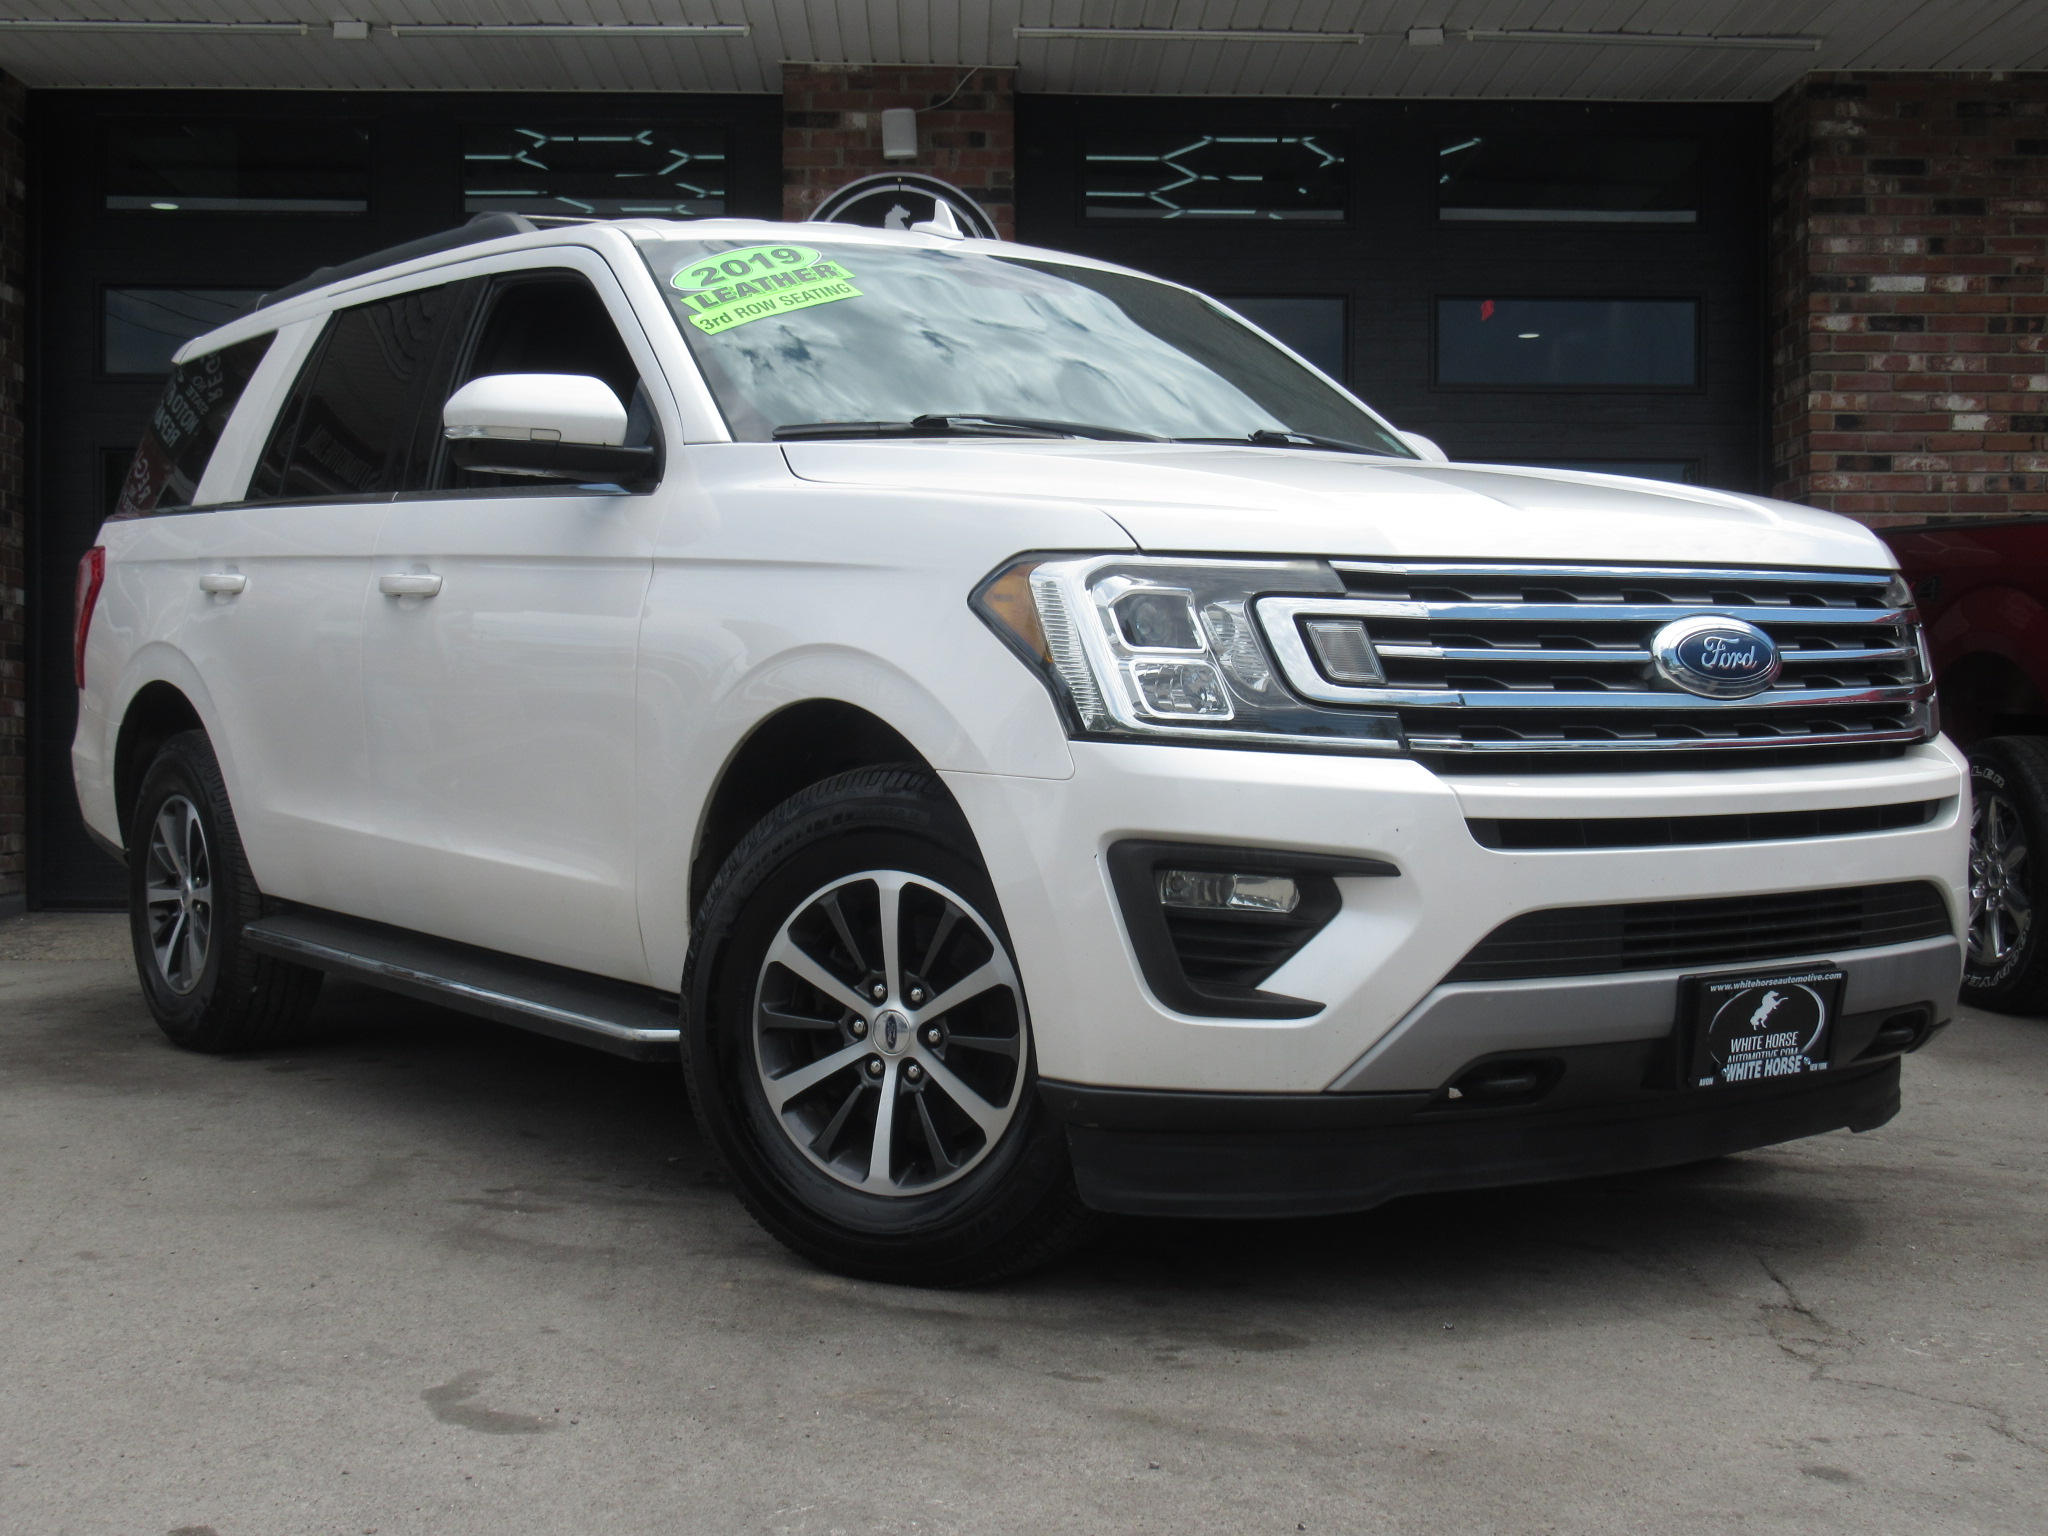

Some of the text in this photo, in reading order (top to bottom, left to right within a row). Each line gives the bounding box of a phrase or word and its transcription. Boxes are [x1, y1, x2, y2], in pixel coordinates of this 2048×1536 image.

[691, 247, 804, 287] 2019
[693, 264, 843, 310] LEATHER
[699, 282, 852, 331] 3rd ROW SEATING
[1701, 636, 1757, 669] Ford
[1710, 972, 1842, 992] www.whitehorseautomotive.com
[1730, 1031, 1799, 1053] WHITE HORSE
[1699, 1077, 1714, 1087] AVON
[1726, 1055, 1803, 1082] WHITE HORSE
